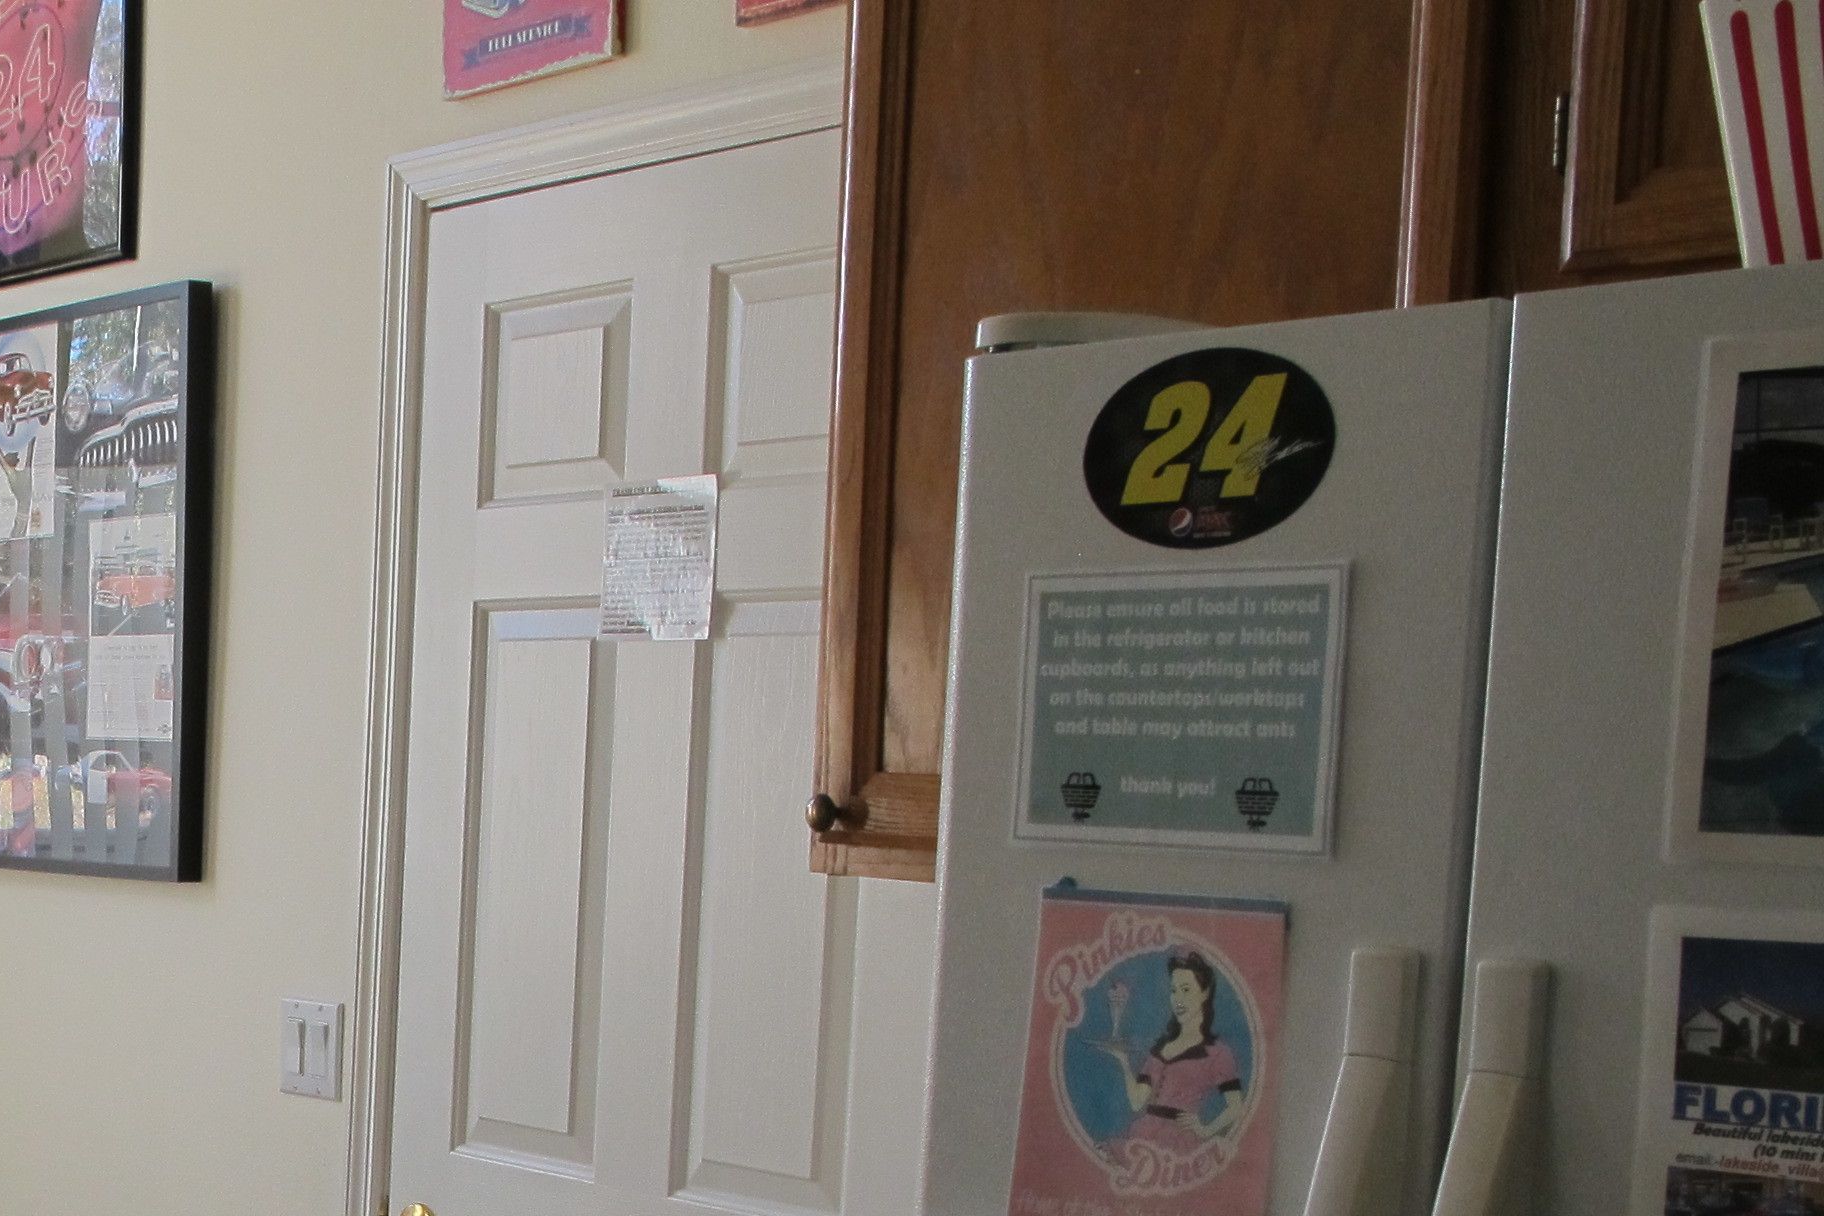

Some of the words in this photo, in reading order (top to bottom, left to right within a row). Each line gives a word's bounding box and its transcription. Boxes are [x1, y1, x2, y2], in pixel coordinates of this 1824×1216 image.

[1121, 372, 1288, 506] 24
[1048, 599, 1102, 619] Please
[1107, 601, 1165, 618] ensure
[1169, 599, 1192, 616] all
[1197, 597, 1238, 616] food
[1243, 597, 1256, 615] is
[1263, 594, 1321, 615] stored
[1053, 630, 1070, 648] in
[1074, 629, 1102, 647] the
[1107, 626, 1210, 649] refrigerator
[1215, 633, 1235, 646] or
[1240, 625, 1311, 645] kitchen
[1139, 664, 1159, 677] as
[1163, 658, 1247, 681] anything
[1251, 659, 1284, 676] left
[1288, 659, 1321, 676] out
[1049, 693, 1072, 706] on
[1075, 688, 1104, 706] the
[1054, 719, 1088, 736] and
[1092, 717, 1138, 736] table
[1142, 720, 1182, 741] may
[1187, 719, 1253, 738] attract
[1256, 721, 1297, 739] ants
[1673, 1082, 1824, 1133] FLORI
[1116, 1141, 1226, 1189] Diner
